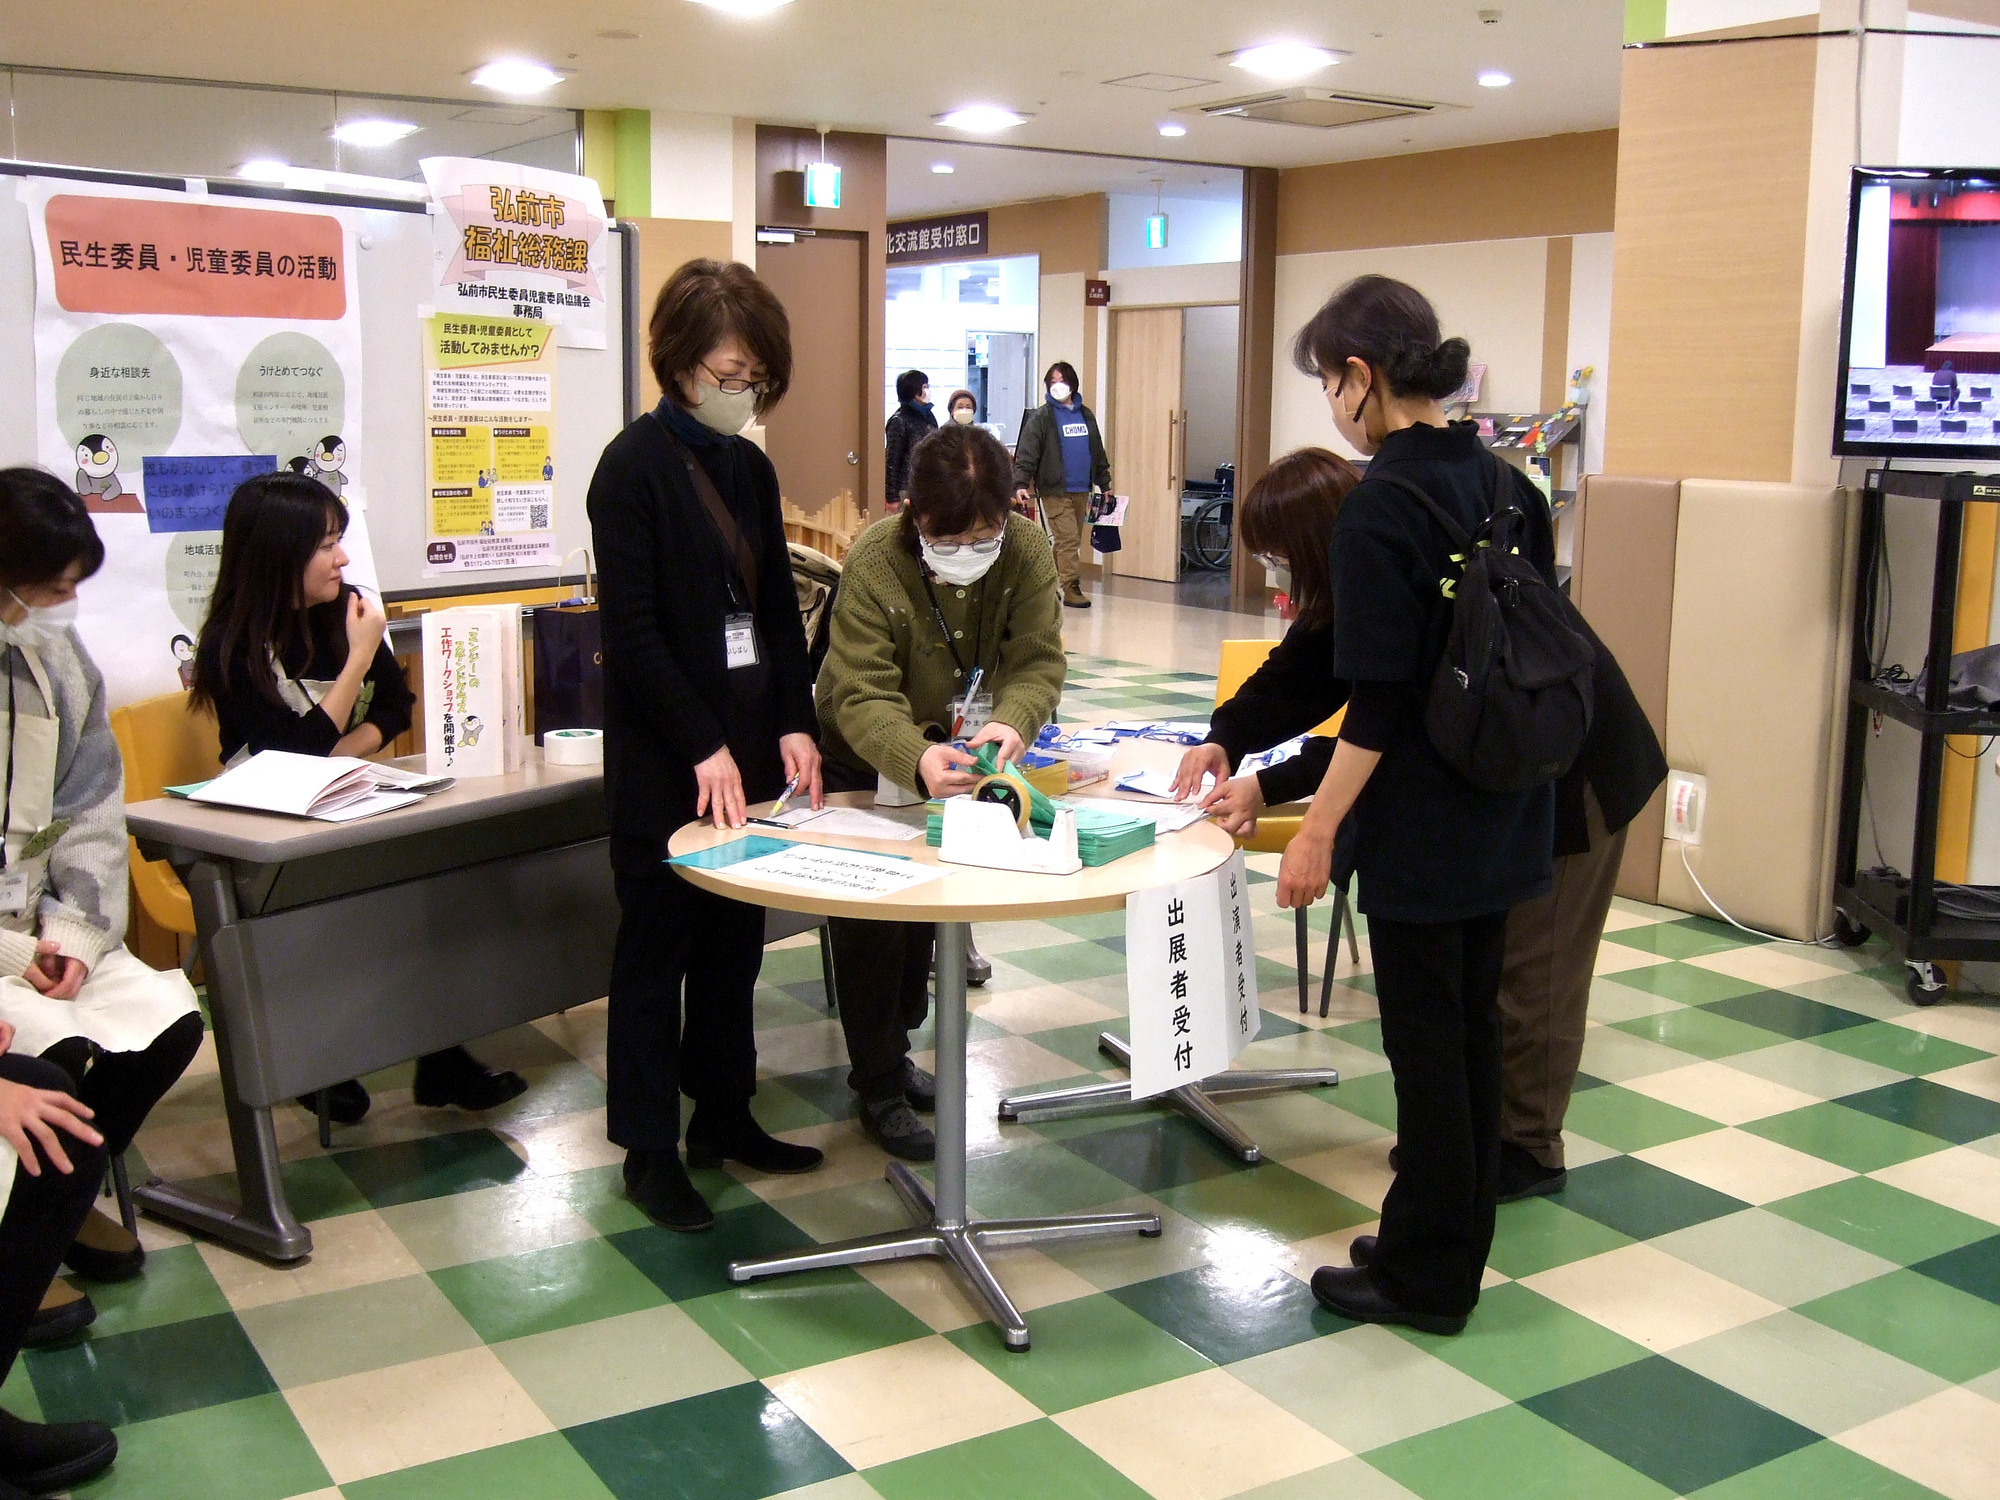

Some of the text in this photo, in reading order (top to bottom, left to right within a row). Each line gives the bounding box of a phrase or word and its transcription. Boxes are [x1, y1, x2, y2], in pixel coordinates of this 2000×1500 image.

[489, 185, 565, 229] 弘前市
[464, 225, 588, 274] 福祉総務課
[885, 223, 980, 254] 化交流館受付窓口
[59, 240, 337, 281] 民生委員・児童委員の活動
[457, 282, 591, 308] 弘前市民生委員児童委員協議会
[512, 304, 543, 319] 事務局
[443, 322, 533, 338] 民生委員・児童委員として
[89, 366, 151, 379] 身近な相談先
[259, 365, 323, 378] うけとめてつなぐ
[1064, 425, 1087, 435] CHUMS
[1229, 871, 1249, 1035] 出演者受付
[1166, 897, 1194, 1072] 出展者受付
